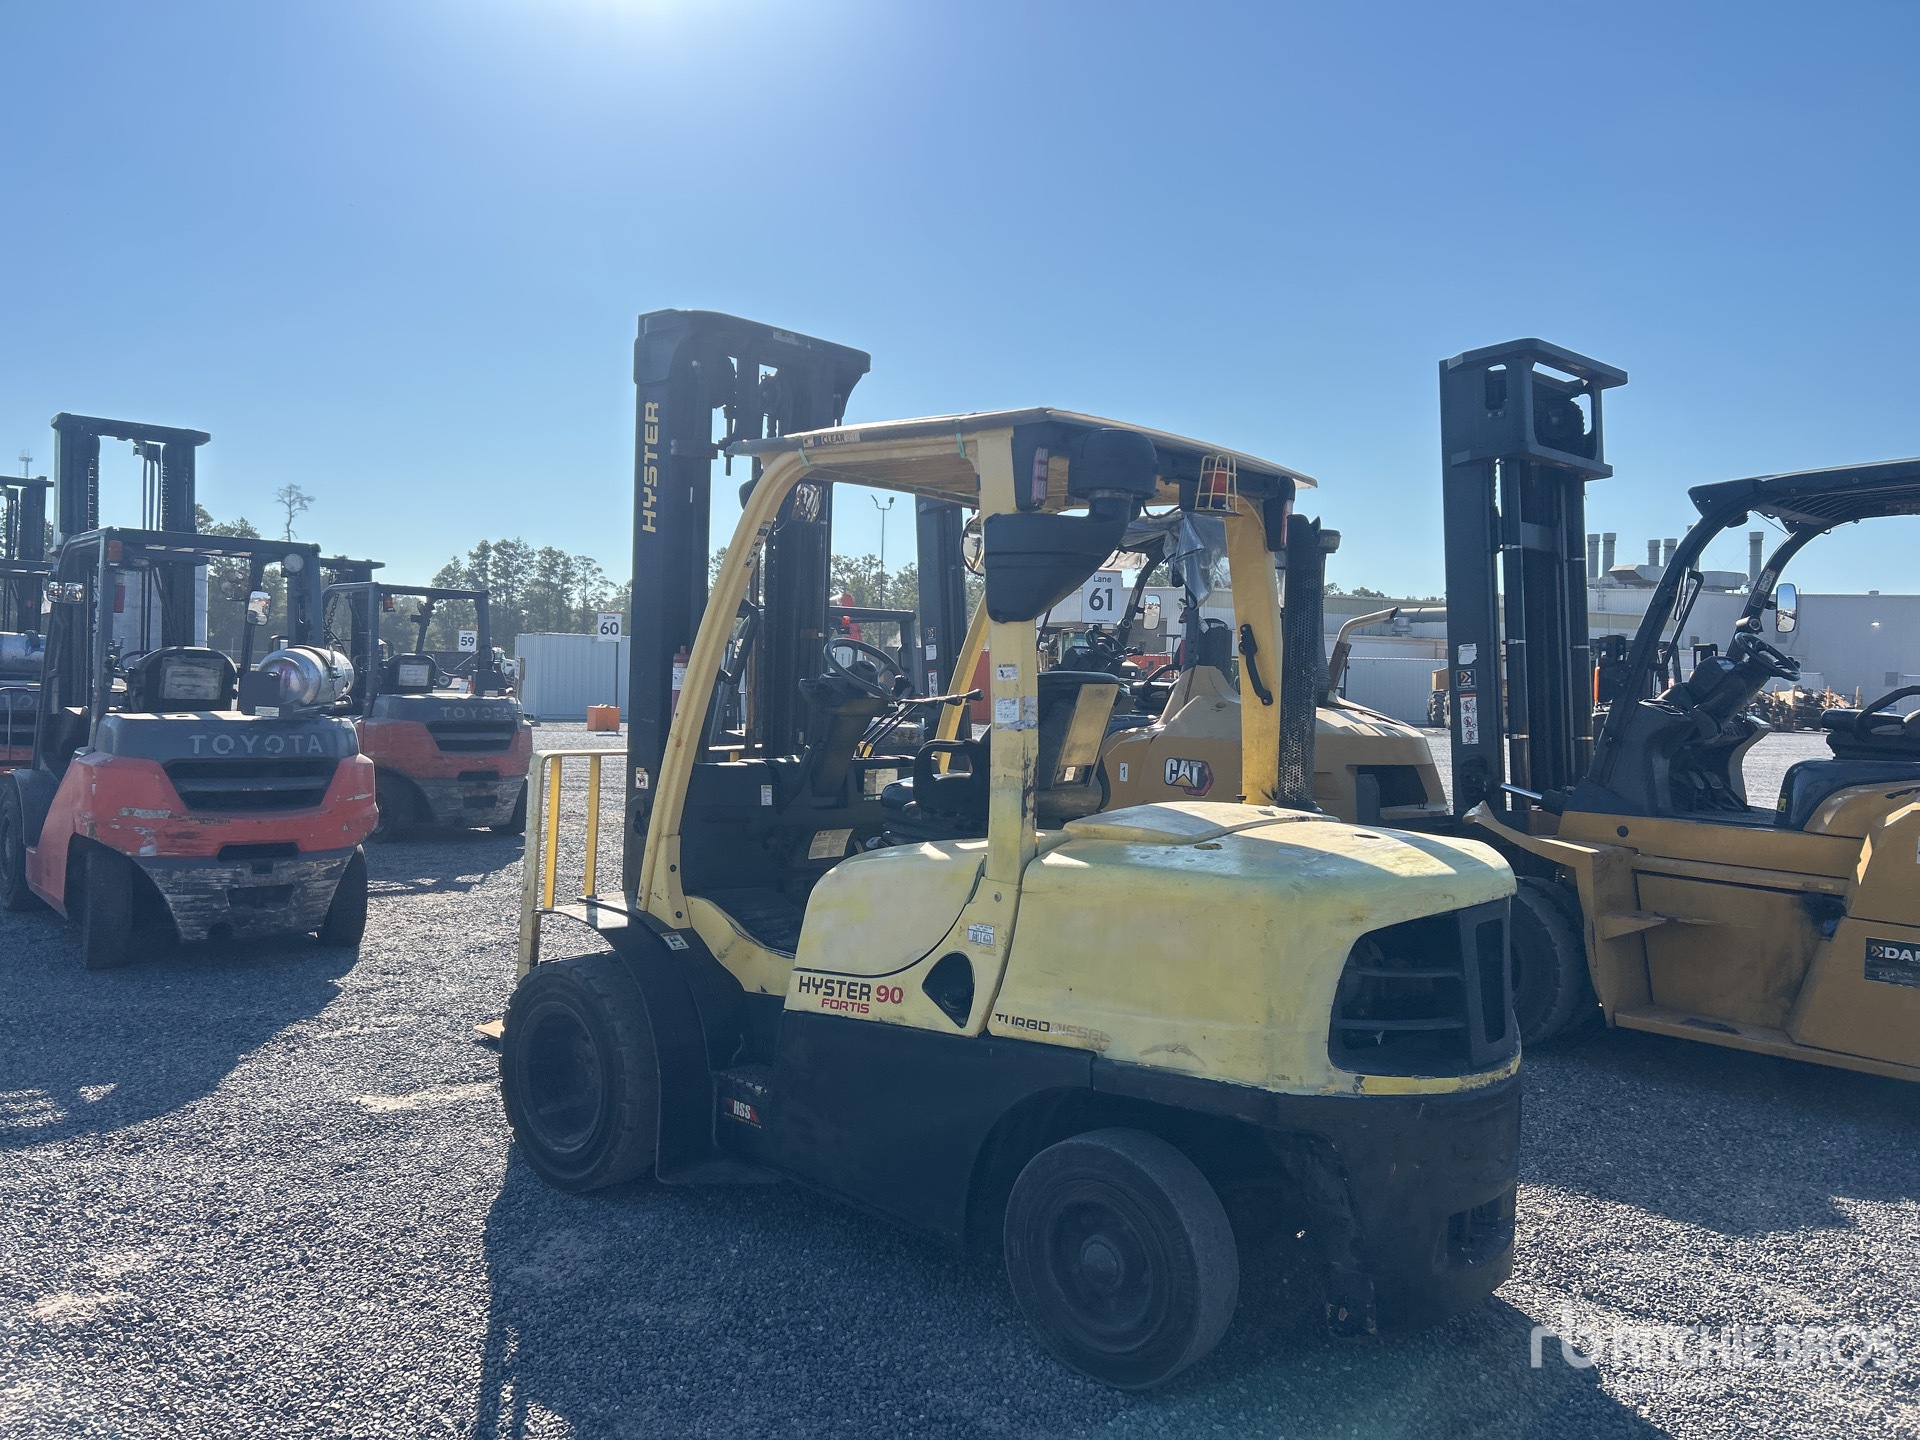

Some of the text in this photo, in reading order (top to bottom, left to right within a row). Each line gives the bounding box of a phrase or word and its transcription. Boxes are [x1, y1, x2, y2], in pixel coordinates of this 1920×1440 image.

[642, 401, 659, 533] HYSTER
[1093, 575, 1112, 583] Lane
[1088, 587, 1113, 611] 61
[600, 621, 619, 636] 60
[460, 636, 475, 647] 59
[440, 706, 512, 721] TOYOTA
[188, 734, 324, 755] TOYOTA
[1121, 766, 1126, 778] 1
[1164, 758, 1203, 788] CAT
[798, 975, 904, 1005] HYSTER 90
[821, 998, 870, 1014] FORTIS
[733, 1100, 751, 1120] HSS
